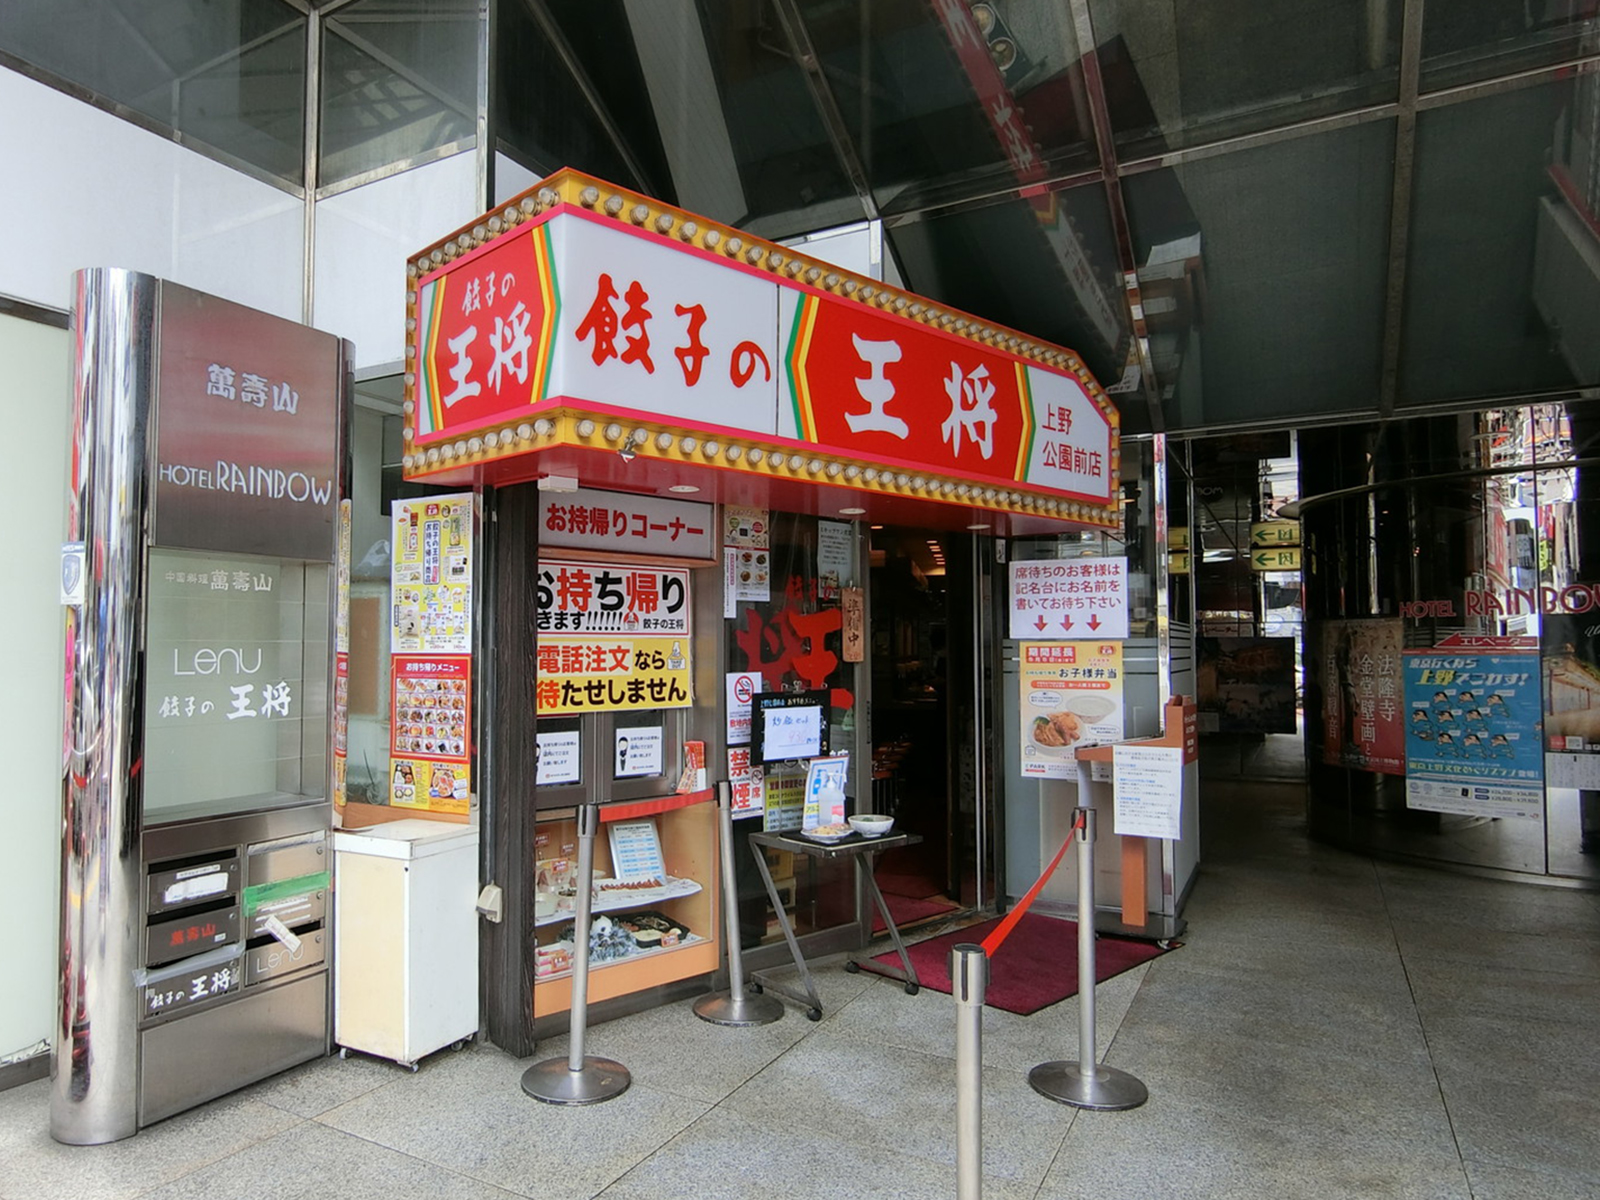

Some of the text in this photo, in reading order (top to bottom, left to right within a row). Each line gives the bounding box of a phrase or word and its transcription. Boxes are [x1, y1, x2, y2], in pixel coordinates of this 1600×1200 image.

[462, 271, 516, 316] 餃子の
[443, 301, 533, 409] 王将
[574, 273, 998, 460] 餃子の 王将
[207, 363, 299, 415] 萬壽山
[1042, 403, 1072, 435] 上野
[1042, 441, 1102, 478] 公園前店
[159, 460, 332, 506] HOTEL RAINBOW
[546, 503, 704, 542] お持帰りコーナー
[210, 569, 273, 592] 萬壽山
[1015, 564, 1121, 579] 席待ちのお客様は
[1015, 580, 1121, 595] 記名台にお名前を
[537, 568, 685, 615] お持ち帰り
[1015, 596, 1121, 610] 書いてお待ち下さい
[1400, 584, 1600, 618] HOTEL RAINBO
[643, 618, 684, 630] 餃子の王将
[537, 644, 665, 674] 電話注文なら
[1460, 636, 1535, 648] エレベーター
[405, 662, 461, 673] お持ち帰りメニュー
[1059, 667, 1118, 679] お子様弁当
[159, 681, 292, 720] 餃子の 王将
[536, 676, 687, 710] 待たせしません
[1377, 654, 1397, 722] 法隆寺
[730, 750, 750, 809] 禁煙
[150, 968, 232, 1009] 餃子の 王将
